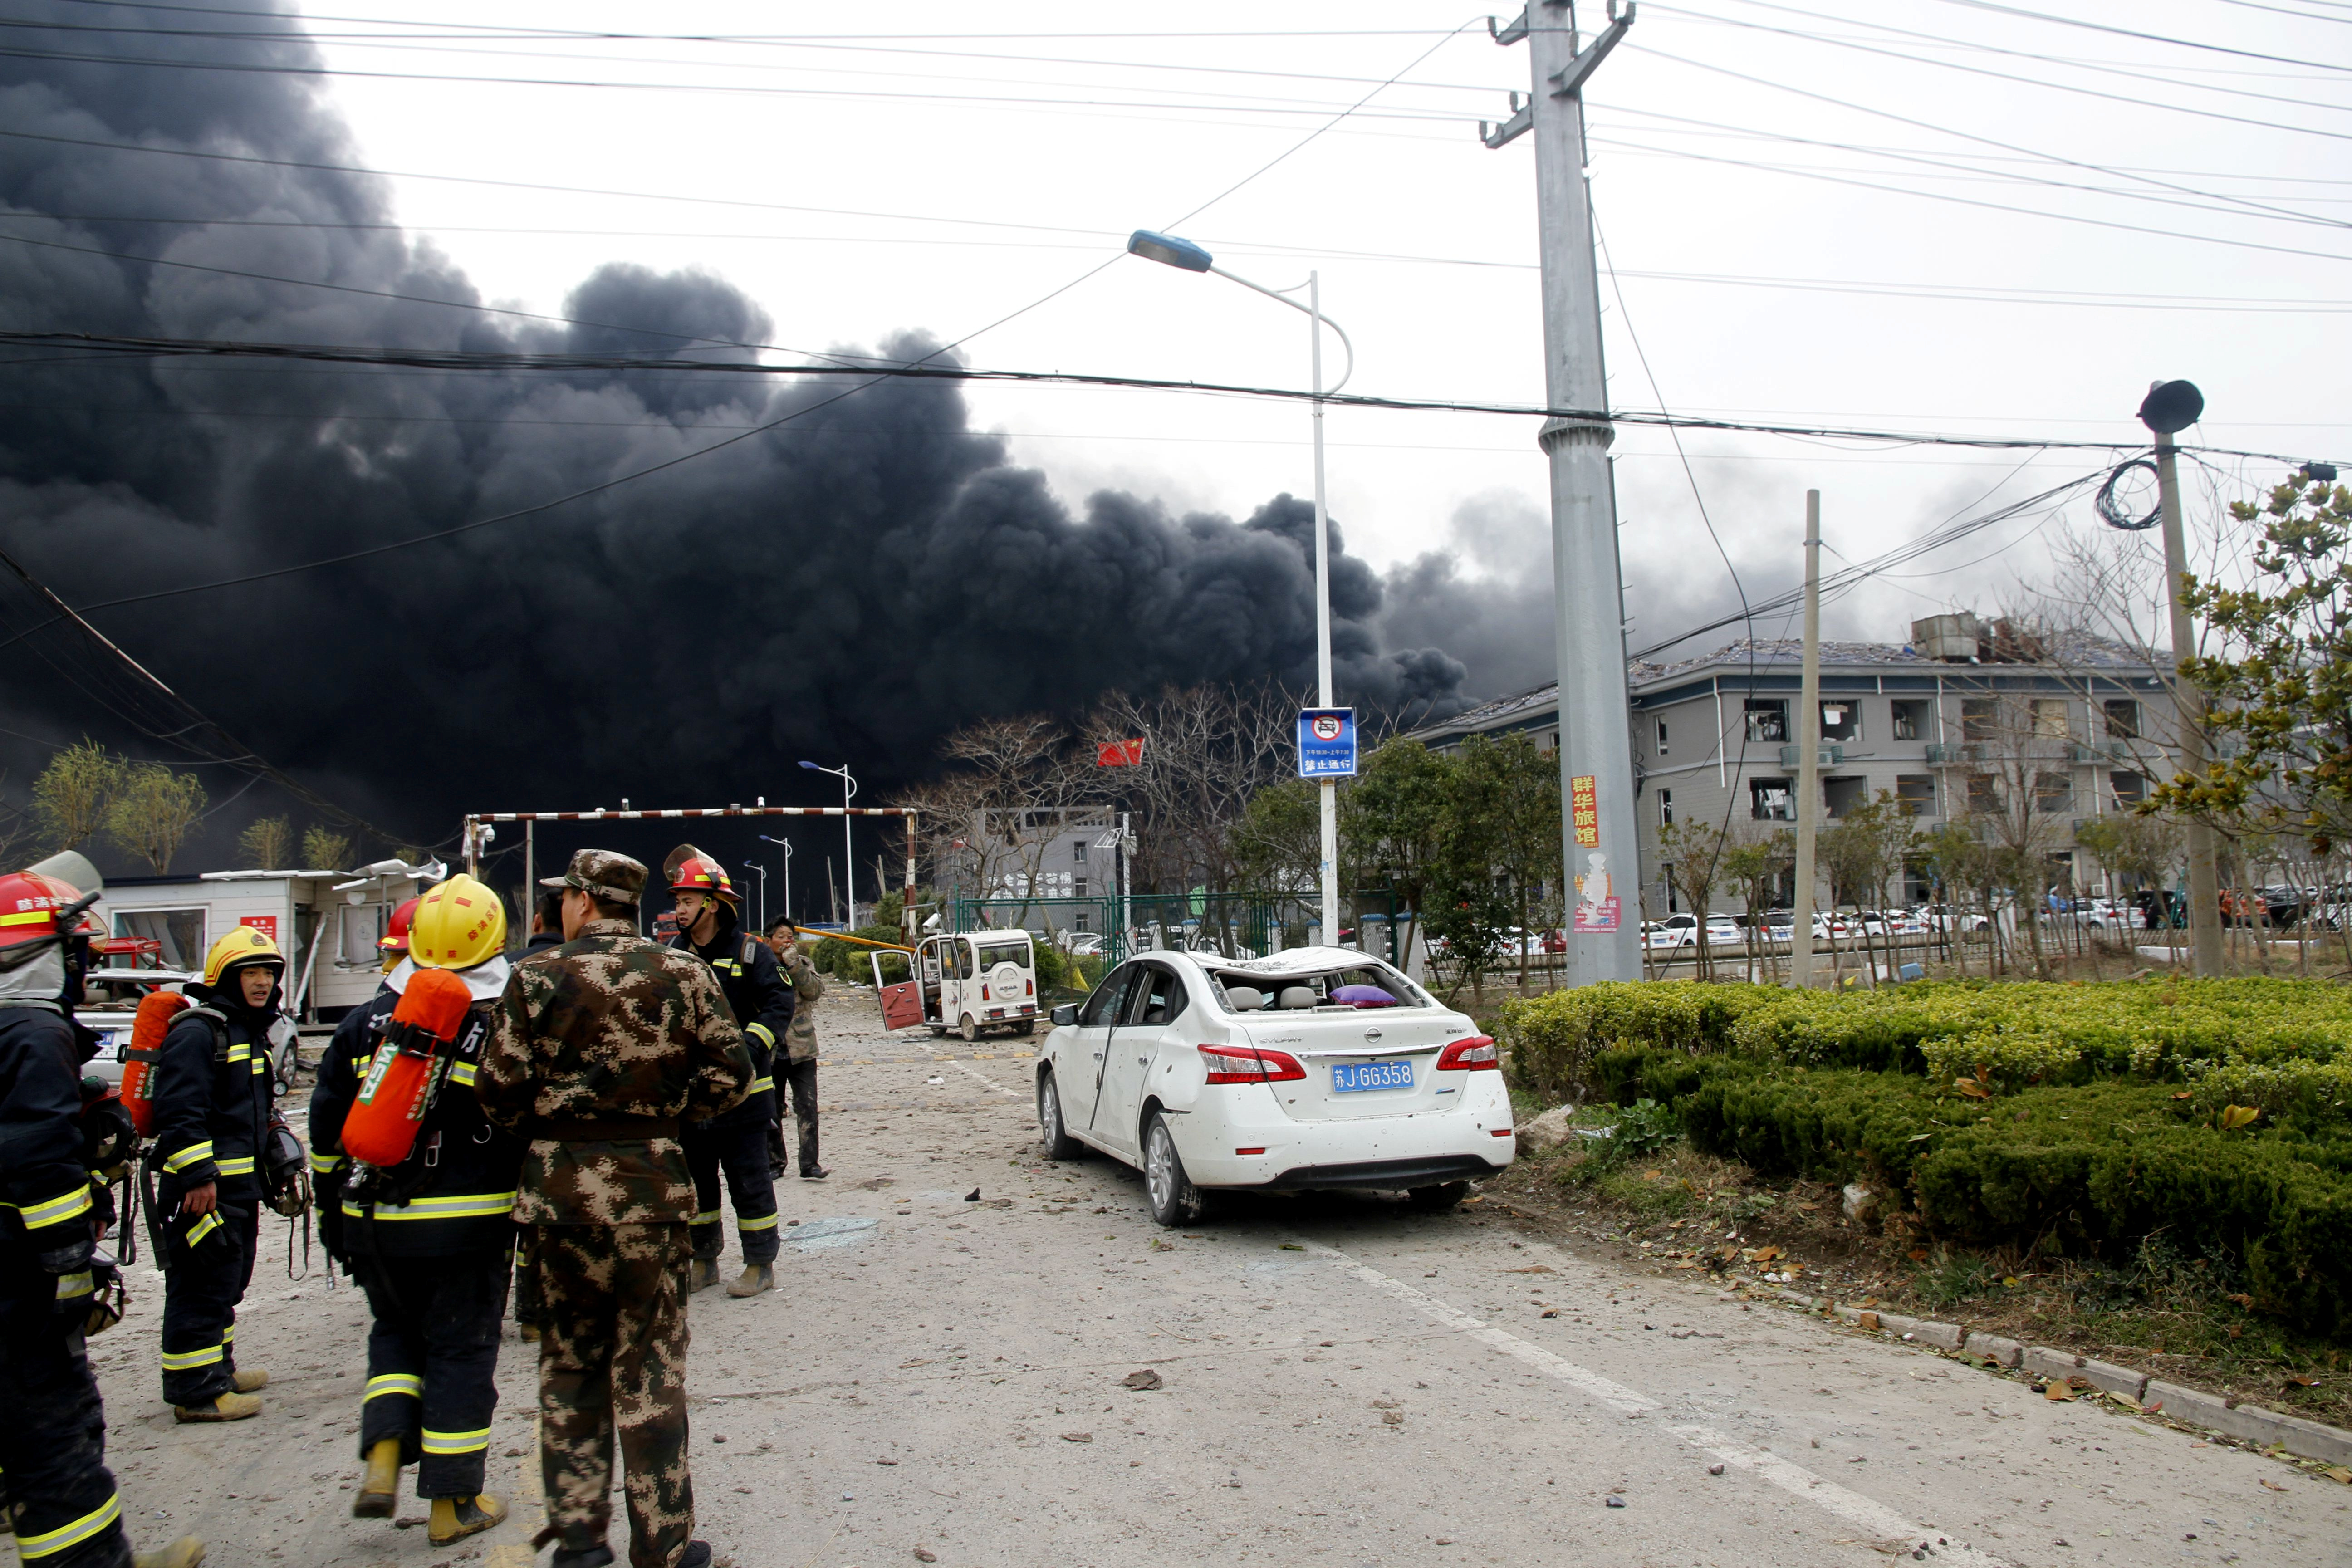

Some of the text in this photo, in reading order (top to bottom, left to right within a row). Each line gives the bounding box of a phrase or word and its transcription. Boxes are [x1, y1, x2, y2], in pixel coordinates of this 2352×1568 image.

[1305, 759, 1351, 771] 禁止通行
[1572, 776, 1596, 843] 群华旅馆
[358, 1043, 399, 1098] MSA
